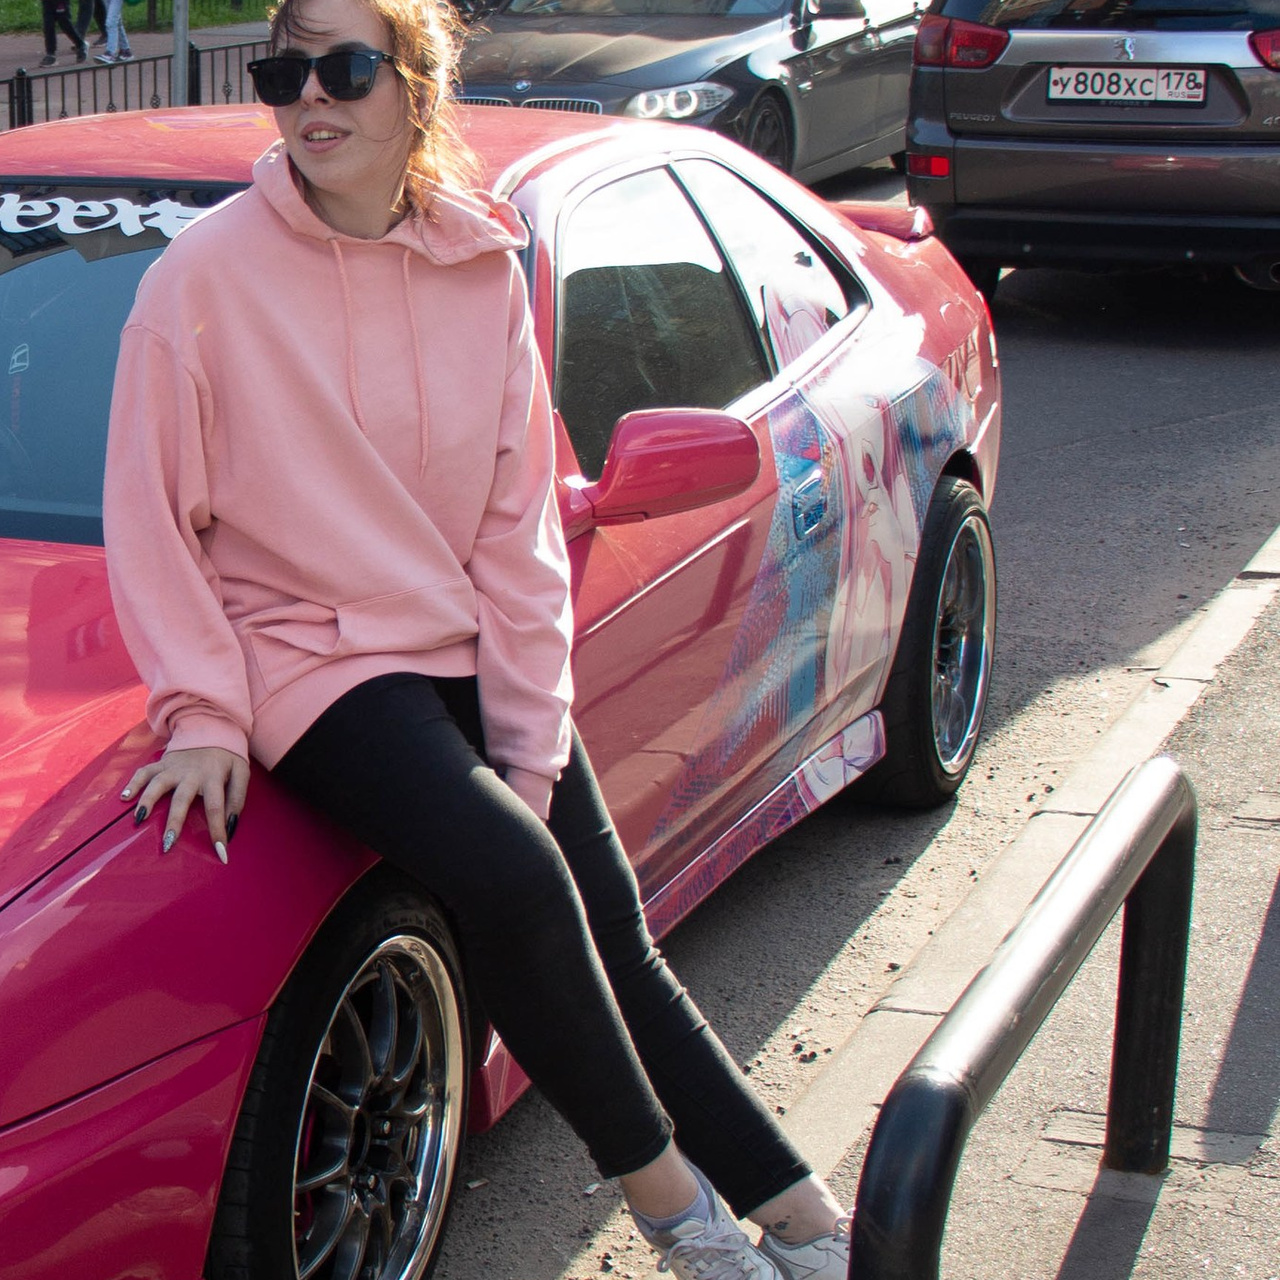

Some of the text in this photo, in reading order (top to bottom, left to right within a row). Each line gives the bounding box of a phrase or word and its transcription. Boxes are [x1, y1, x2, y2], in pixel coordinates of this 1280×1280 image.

[1160, 72, 1198, 91] 178
[1166, 91, 1187, 99] RUS
[949, 112, 997, 122] PEUGEOT
